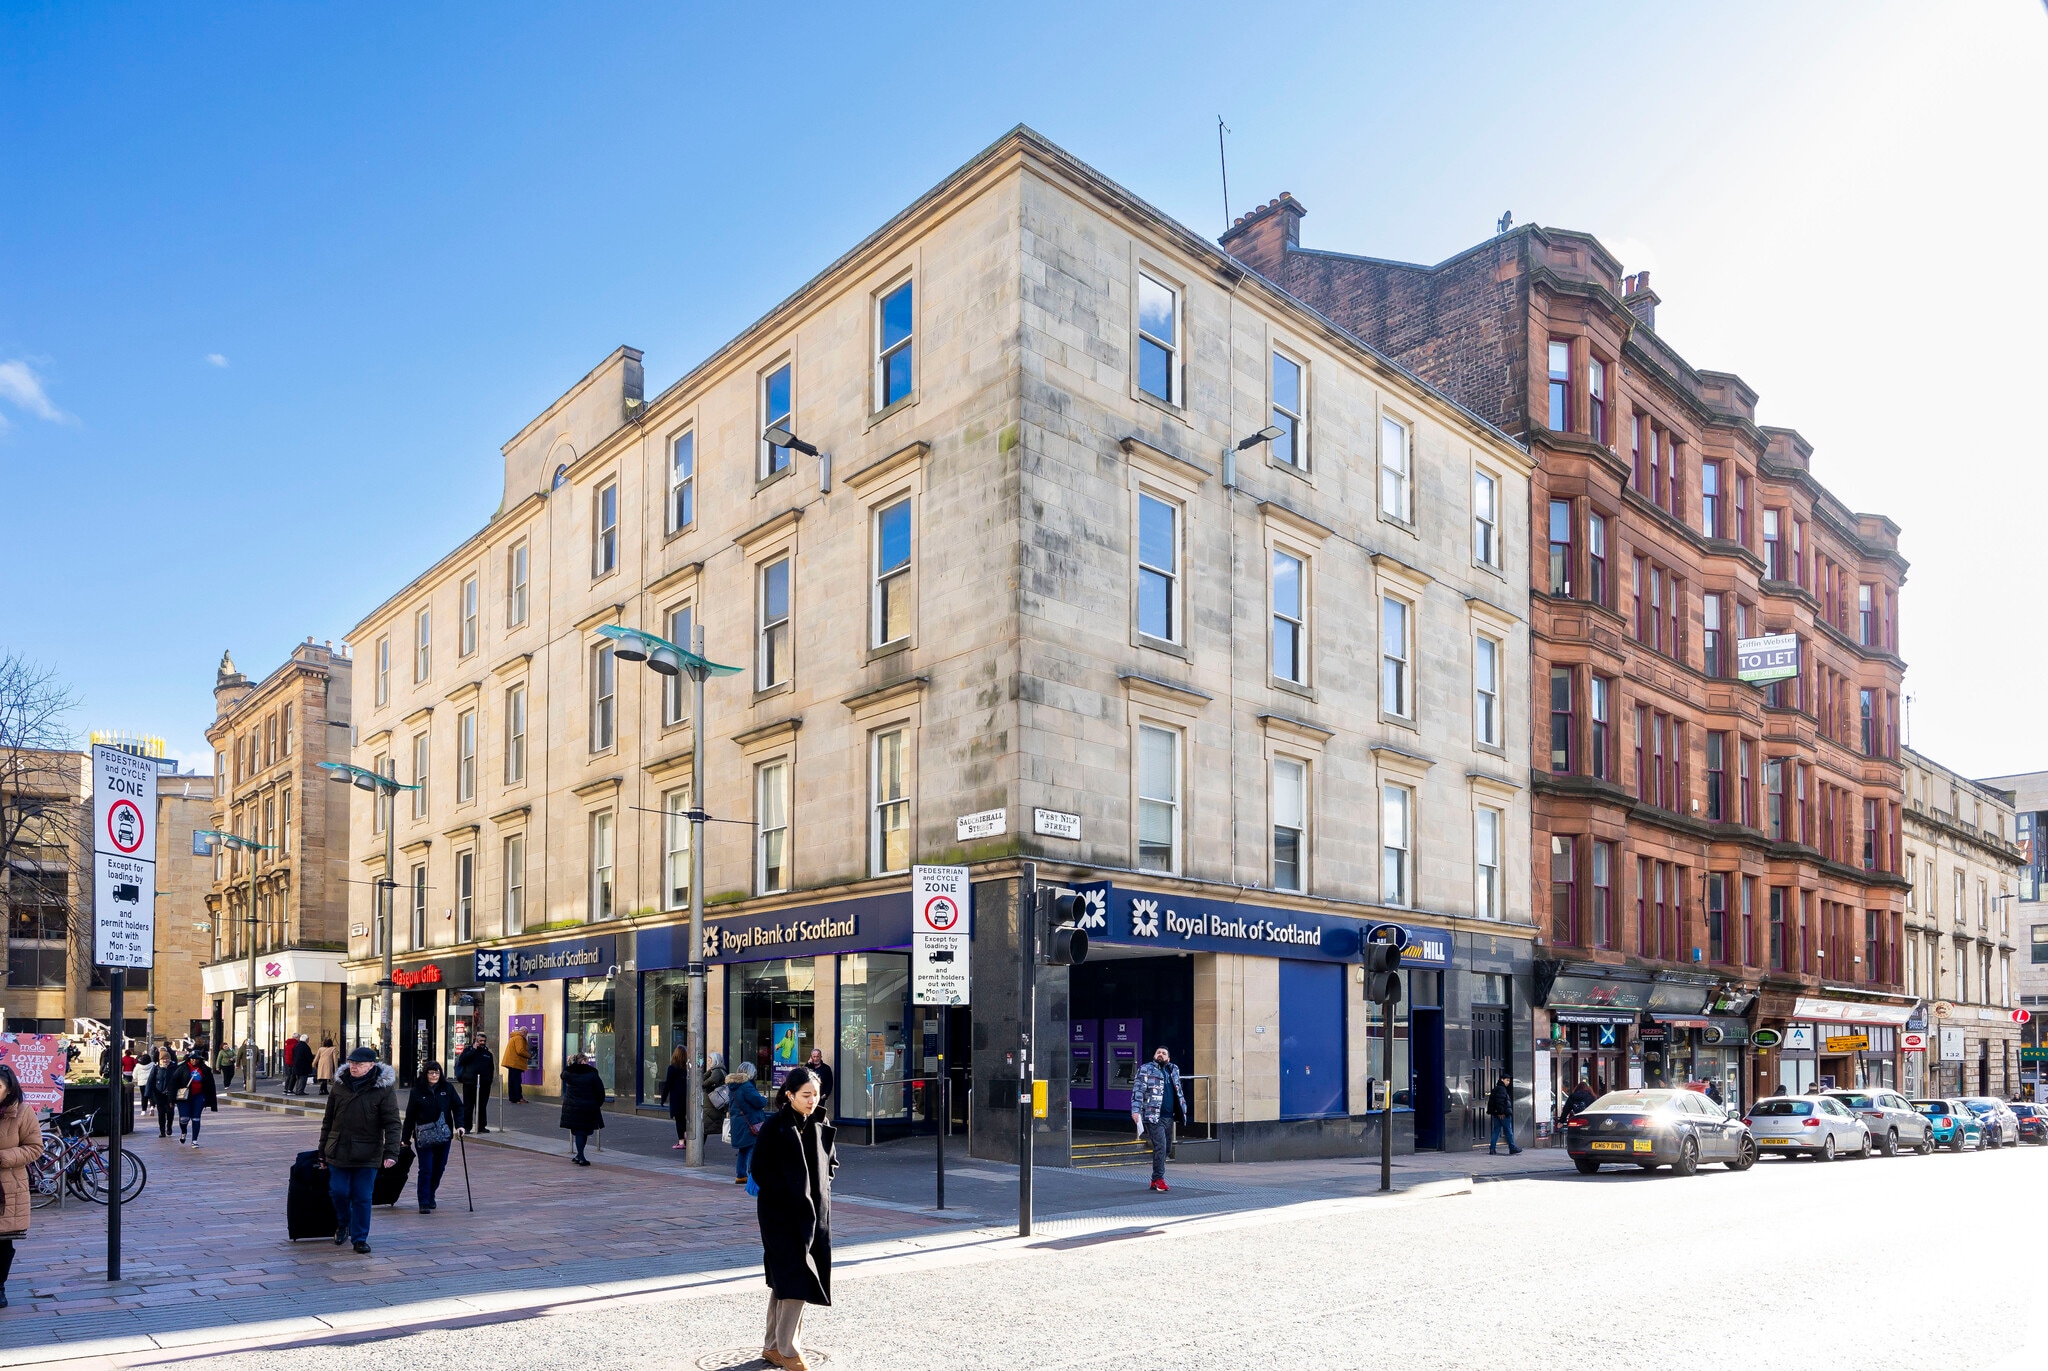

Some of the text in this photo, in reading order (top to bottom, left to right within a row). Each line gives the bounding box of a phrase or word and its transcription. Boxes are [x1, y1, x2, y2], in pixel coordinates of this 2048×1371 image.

[1764, 638, 1795, 646] Webster
[1739, 651, 1794, 668] TO LET
[100, 750, 150, 772] PEDESTRIAN
[105, 764, 146, 781] and CYCLE
[108, 776, 144, 798] ZONE
[1039, 810, 1058, 820] WEST
[1044, 820, 1072, 832] STREET
[108, 859, 144, 872] Except for
[108, 870, 144, 884] loading by
[925, 882, 956, 892] ZONE
[120, 910, 132, 918] and
[101, 920, 150, 931] permit holders
[1166, 909, 1321, 946] Royal Bank of Scotland
[112, 931, 139, 940] out with
[723, 914, 854, 953] Royal Bank of Scotland
[109, 941, 124, 950] Mon
[128, 942, 142, 952] Sun
[1424, 940, 1446, 960] HILL
[520, 946, 598, 974] Royal Bank of Scotland
[392, 964, 442, 989] Glasgow Gifts
[20, 1041, 46, 1052] maia
[12, 1054, 54, 1064] LOVELY
[16, 1062, 48, 1070] GIFTS
[16, 1076, 44, 1084] MUM
